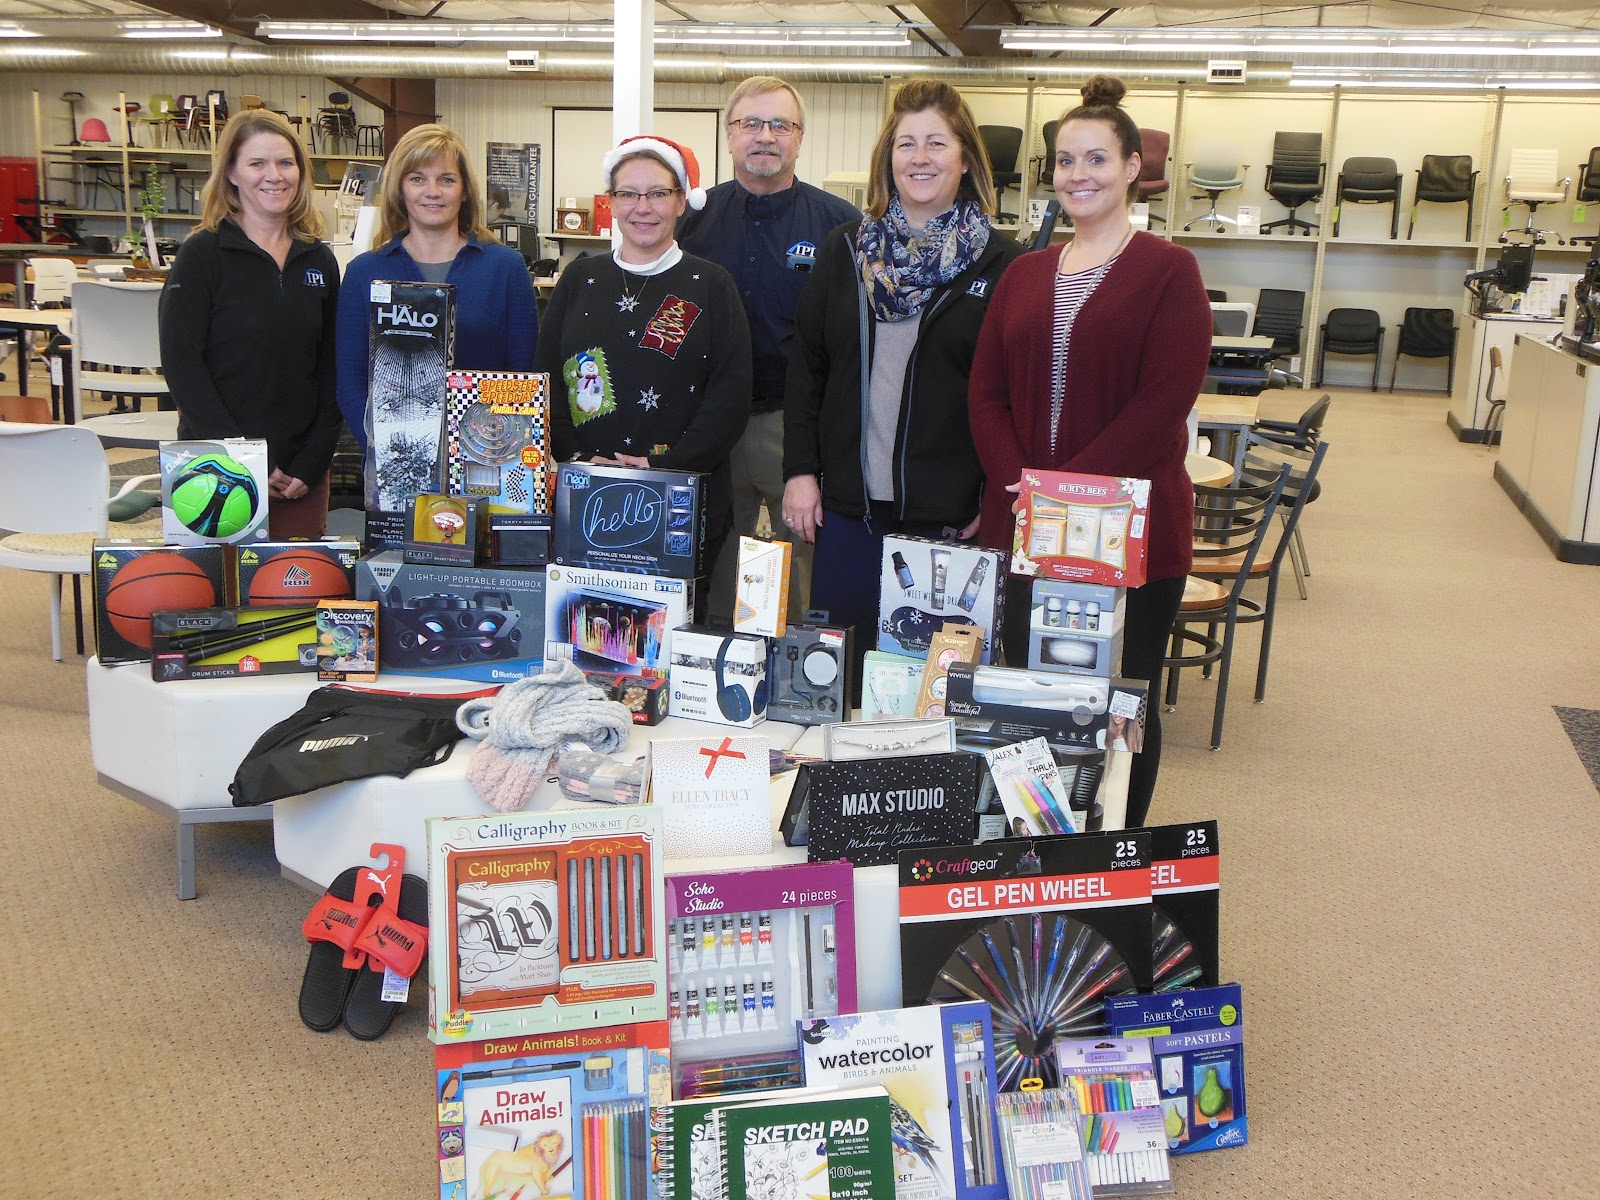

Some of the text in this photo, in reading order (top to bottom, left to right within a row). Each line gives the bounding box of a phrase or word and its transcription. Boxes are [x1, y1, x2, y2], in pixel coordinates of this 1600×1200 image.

[528, 147, 537, 201] GUARANTEE
[795, 245, 815, 258] IPI
[306, 272, 325, 285] IPI
[377, 304, 438, 328] HALO
[480, 379, 539, 391] SPEEDSTER
[480, 391, 535, 403] SPEEDWAY
[489, 405, 540, 416] PINBALL GAME
[1058, 483, 1108, 496] BURT'S BEES
[590, 488, 665, 538] hello
[367, 520, 390, 528] RETRO
[370, 533, 404, 541] ROULETTE
[586, 550, 617, 559] PERSONALIZE
[283, 579, 312, 587] RBX
[408, 573, 542, 588] LIGHT-UP PORTABLE BOOMBOX
[566, 572, 648, 591] Smithsonian
[655, 583, 682, 593] STEM
[903, 589, 921, 599] SWEET
[923, 590, 945, 604] WITER
[322, 611, 372, 623] Discovery
[498, 671, 524, 679] Bluetooth
[681, 693, 707, 704] Bluetooth
[948, 700, 970, 709] Simply
[951, 705, 981, 716] Beautiful
[298, 736, 361, 753] PUMA
[995, 750, 1013, 761] ALEX
[672, 789, 751, 803] ELLEN TRACY
[841, 787, 944, 817] MAX STUDIO
[477, 819, 622, 841] Calligraphy BOOK & KIT
[863, 823, 923, 837] Total Nudes
[1187, 829, 1207, 845] 25
[846, 836, 940, 852] Makeup Collection
[1116, 841, 1137, 858] 25
[1181, 845, 1210, 857] pieces
[468, 858, 551, 878] Calligraphy
[936, 859, 998, 876] Craftgear
[1111, 858, 1141, 870] pieces
[684, 881, 715, 898] Soho
[781, 889, 837, 904] 24 pieces
[947, 877, 1112, 909] GEL PEN WHEEL
[684, 897, 724, 914] Studio
[326, 907, 359, 929] PUMA
[380, 923, 415, 952] PUMA
[518, 973, 535, 981] Matt
[1143, 1006, 1213, 1023] FABER-CASTELL
[445, 1019, 469, 1027] Puddle
[484, 1033, 626, 1056] Draw Animals! Book & Kit
[856, 1035, 900, 1047] PAINTING
[1166, 1031, 1231, 1047] SOFT PASTELS
[818, 1042, 934, 1070] watercolor
[843, 1064, 917, 1079] BIRDS & ANIMALS
[496, 1090, 546, 1107] Draw
[479, 1101, 563, 1126] Animals!
[743, 1118, 869, 1145] SKETCH PAD
[1146, 1140, 1157, 1148] 36
[829, 1165, 854, 1179] 100
[898, 1173, 914, 1183] SET
[832, 1189, 868, 1199] 8x10 inch
